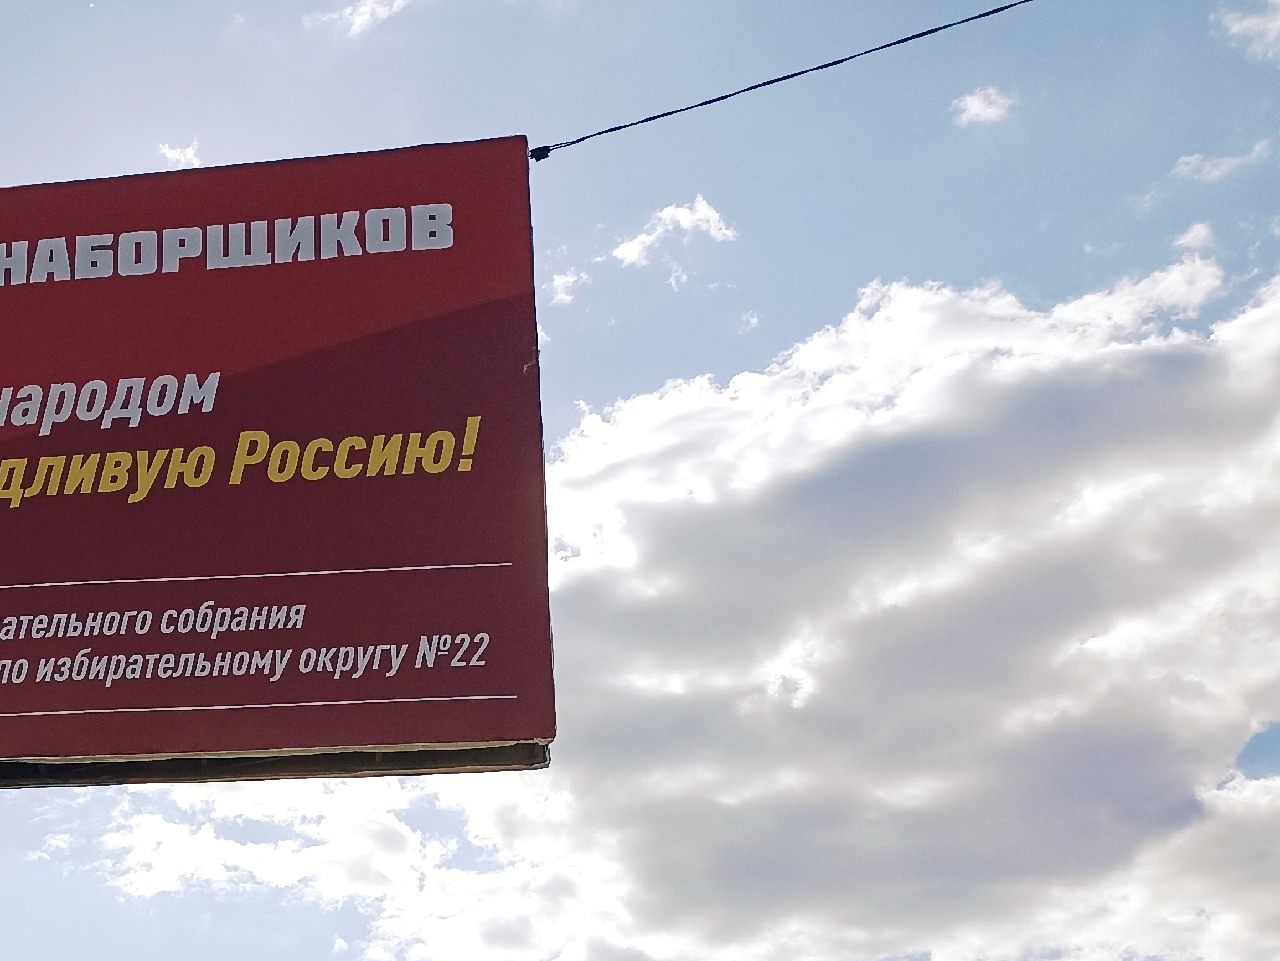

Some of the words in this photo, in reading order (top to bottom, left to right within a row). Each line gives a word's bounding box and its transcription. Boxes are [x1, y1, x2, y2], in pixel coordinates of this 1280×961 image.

[228, 415, 482, 485] Россию!
[160, 600, 307, 640] собрания
[35, 647, 293, 688] избирательному
[298, 643, 409, 680] округу
[414, 632, 490, 669] №22
